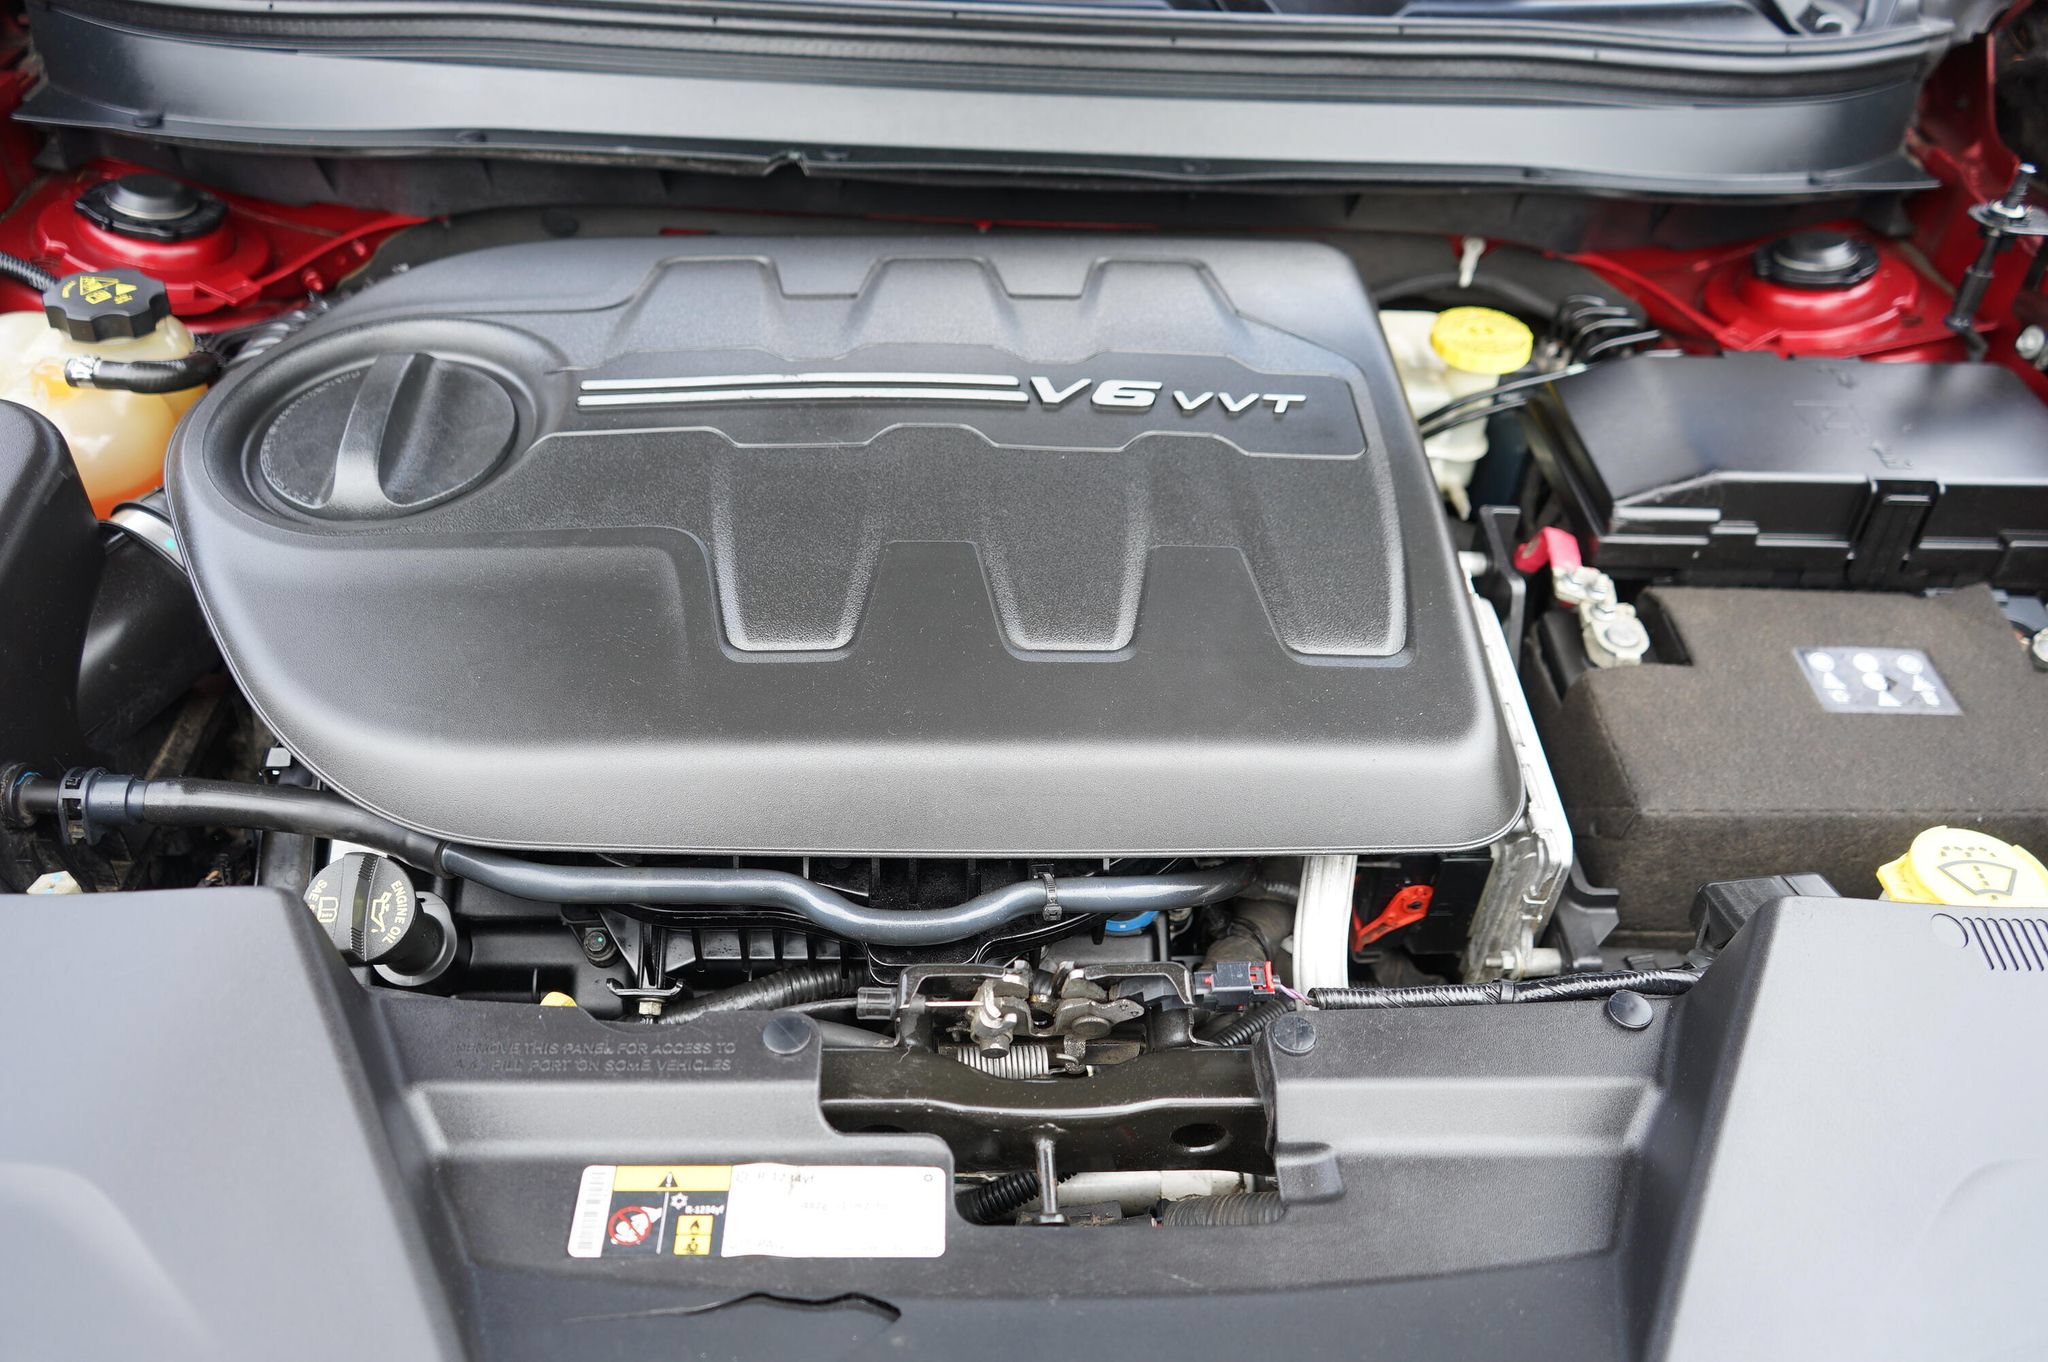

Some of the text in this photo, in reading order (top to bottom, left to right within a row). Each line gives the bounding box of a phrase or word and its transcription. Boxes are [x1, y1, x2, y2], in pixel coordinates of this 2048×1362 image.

[1030, 376, 1308, 414] V6 VVT
[308, 879, 328, 902] SAE
[381, 879, 408, 944] ENGINE OIL
[524, 1042, 560, 1055] THIS
[562, 1042, 615, 1055] PANEL
[617, 1042, 649, 1055] FOR
[651, 1042, 713, 1055] ACCESS
[716, 1042, 737, 1055] TO
[527, 1060, 572, 1072] PORT
[576, 1060, 600, 1072] ON
[604, 1059, 652, 1072] SOME
[656, 1059, 732, 1072] VEHICLES
